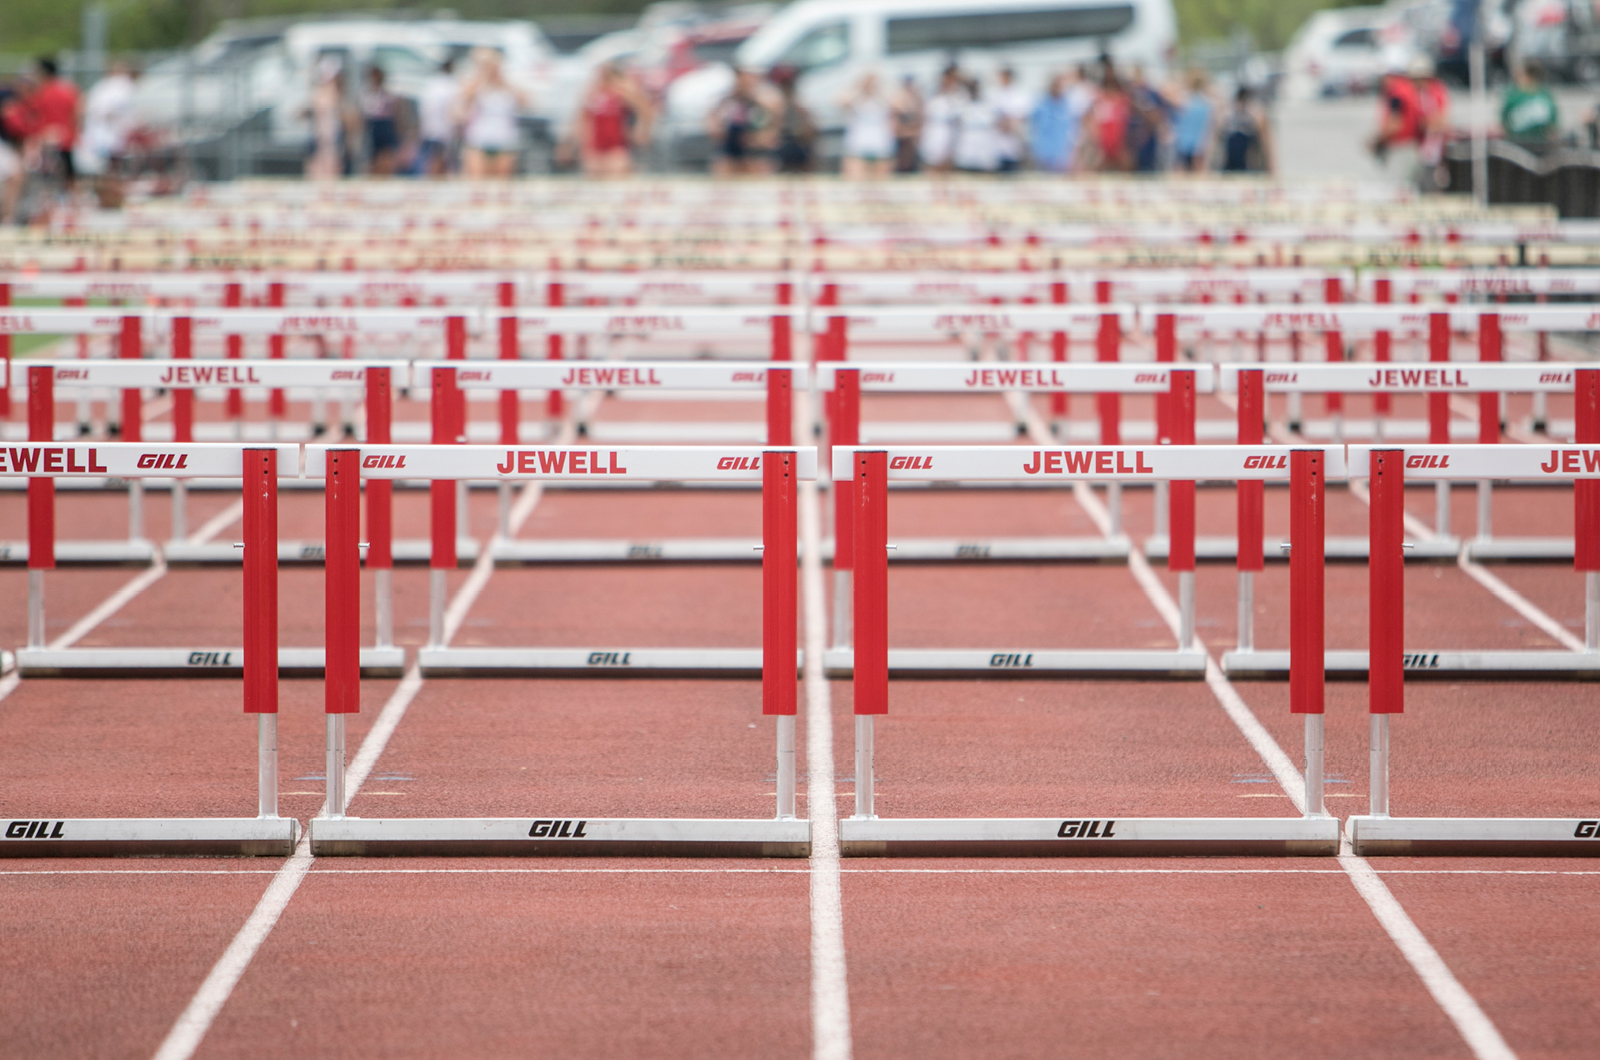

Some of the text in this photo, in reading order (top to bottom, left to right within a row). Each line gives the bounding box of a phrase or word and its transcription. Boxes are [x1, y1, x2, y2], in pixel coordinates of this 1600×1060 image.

[278, 315, 358, 332] JEWELL
[607, 315, 683, 331] JEWELL
[934, 314, 1011, 330] JEWELL
[1263, 313, 1343, 330] JEWELL
[56, 366, 364, 384] GILL JEWELL GILL
[460, 367, 766, 386] GILL JEWELL GILL
[862, 369, 1167, 387] GILL JEWELL GILL
[1264, 369, 1572, 388] GILL JEWELL GILL
[0, 448, 188, 473] WELL GILL
[362, 450, 760, 475] GILL JEWELL GILL
[889, 450, 1287, 475] GILL JEWELL GILL
[1406, 450, 1600, 474] GILL JEW
[187, 651, 232, 667] GILL
[587, 652, 632, 667] GILL
[989, 653, 1034, 668] GILL
[5, 820, 65, 838] GILL
[528, 820, 587, 838] GILL
[1057, 820, 1116, 838] GILL
